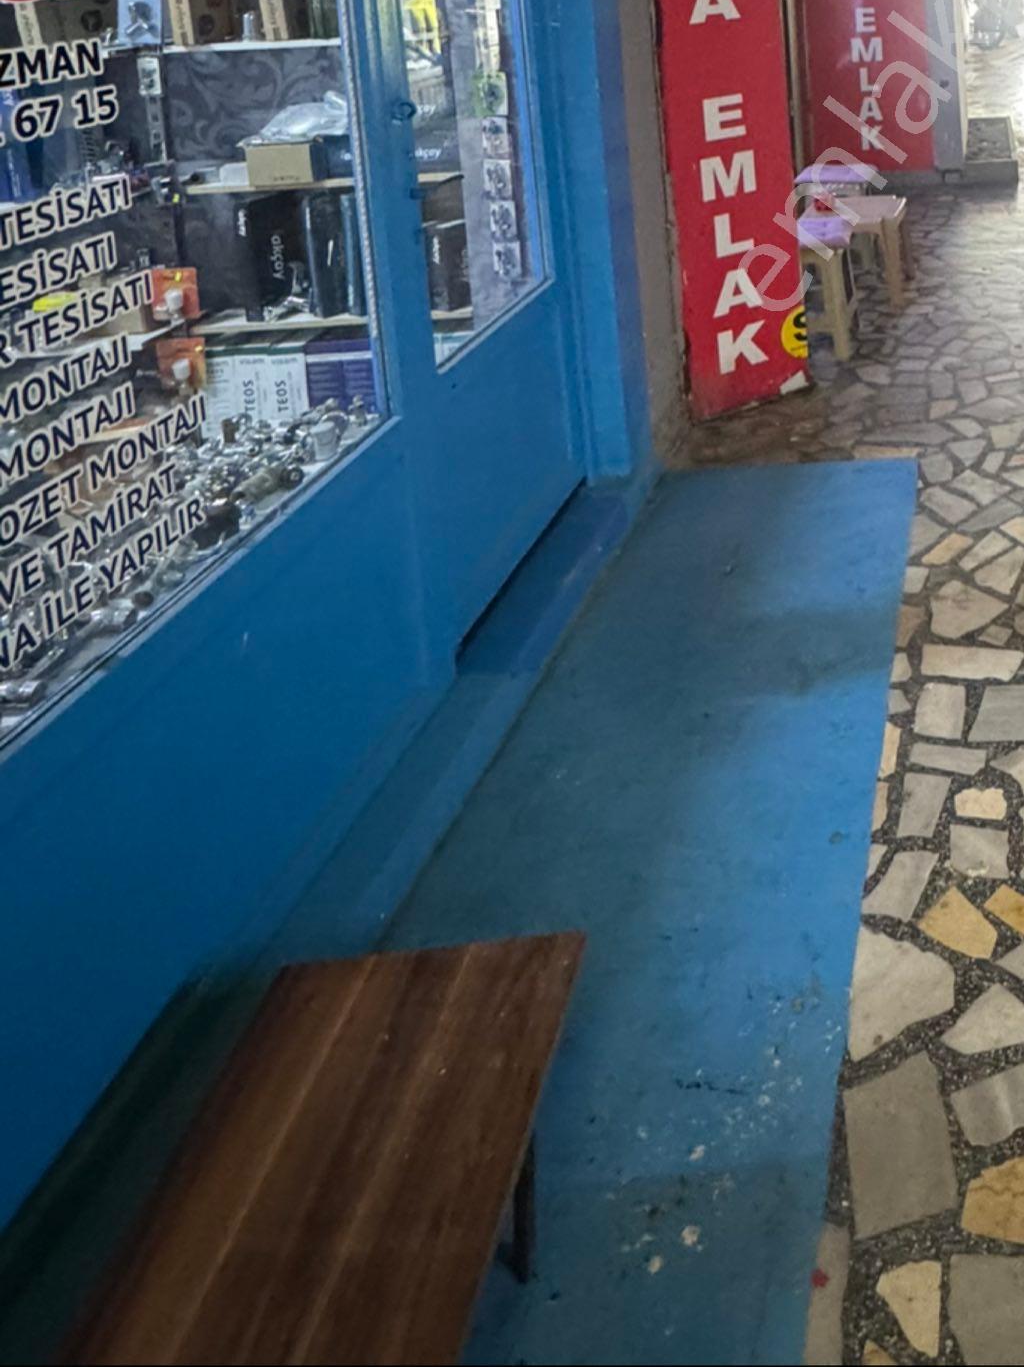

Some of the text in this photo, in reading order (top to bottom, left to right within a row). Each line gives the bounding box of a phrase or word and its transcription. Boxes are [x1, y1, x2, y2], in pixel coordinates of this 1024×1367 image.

[14, 89, 117, 138] 67 15
[851, 7, 884, 151] EMLAK
[270, 235, 285, 280] akçay
[700, 94, 768, 375] EMLAK
[19, 273, 152, 353] TESİSATI
[242, 378, 256, 412] TEOS
[274, 379, 289, 413] TEOS
[90, 396, 206, 490] MONTAJI
[48, 464, 175, 569] TAMİRAT
[43, 577, 93, 635] İLE
[100, 499, 203, 589] YAPILIR
